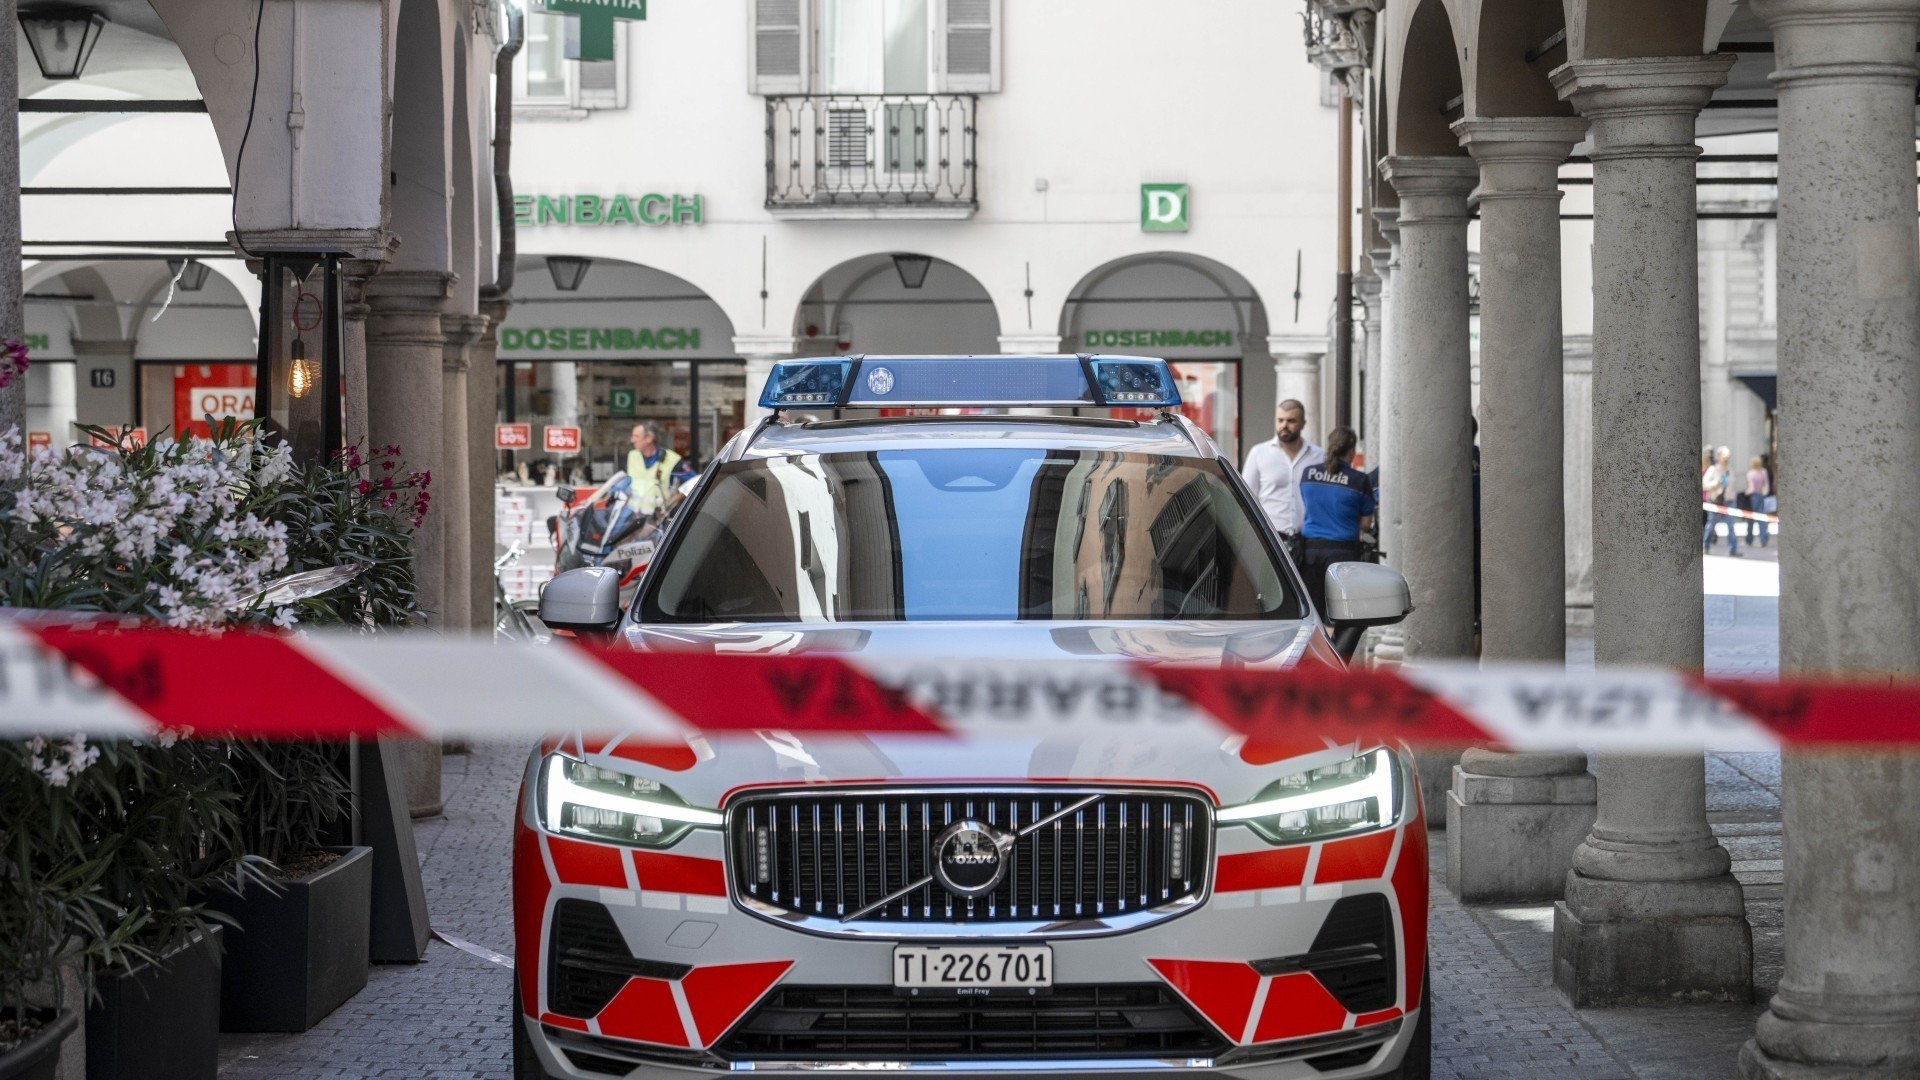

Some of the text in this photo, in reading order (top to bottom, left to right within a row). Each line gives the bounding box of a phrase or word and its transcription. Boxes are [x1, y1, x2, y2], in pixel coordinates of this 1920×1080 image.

[513, 193, 703, 225] ENBACH
[1148, 189, 1182, 223] D
[501, 328, 700, 350] DOSENBACH
[1085, 330, 1231, 347] DOSENBACH
[94, 371, 112, 386] 16
[1308, 468, 1349, 486] Polizia
[617, 545, 652, 559] Polizia
[946, 854, 997, 864] VOLVO
[974, 988, 990, 996] Frey
